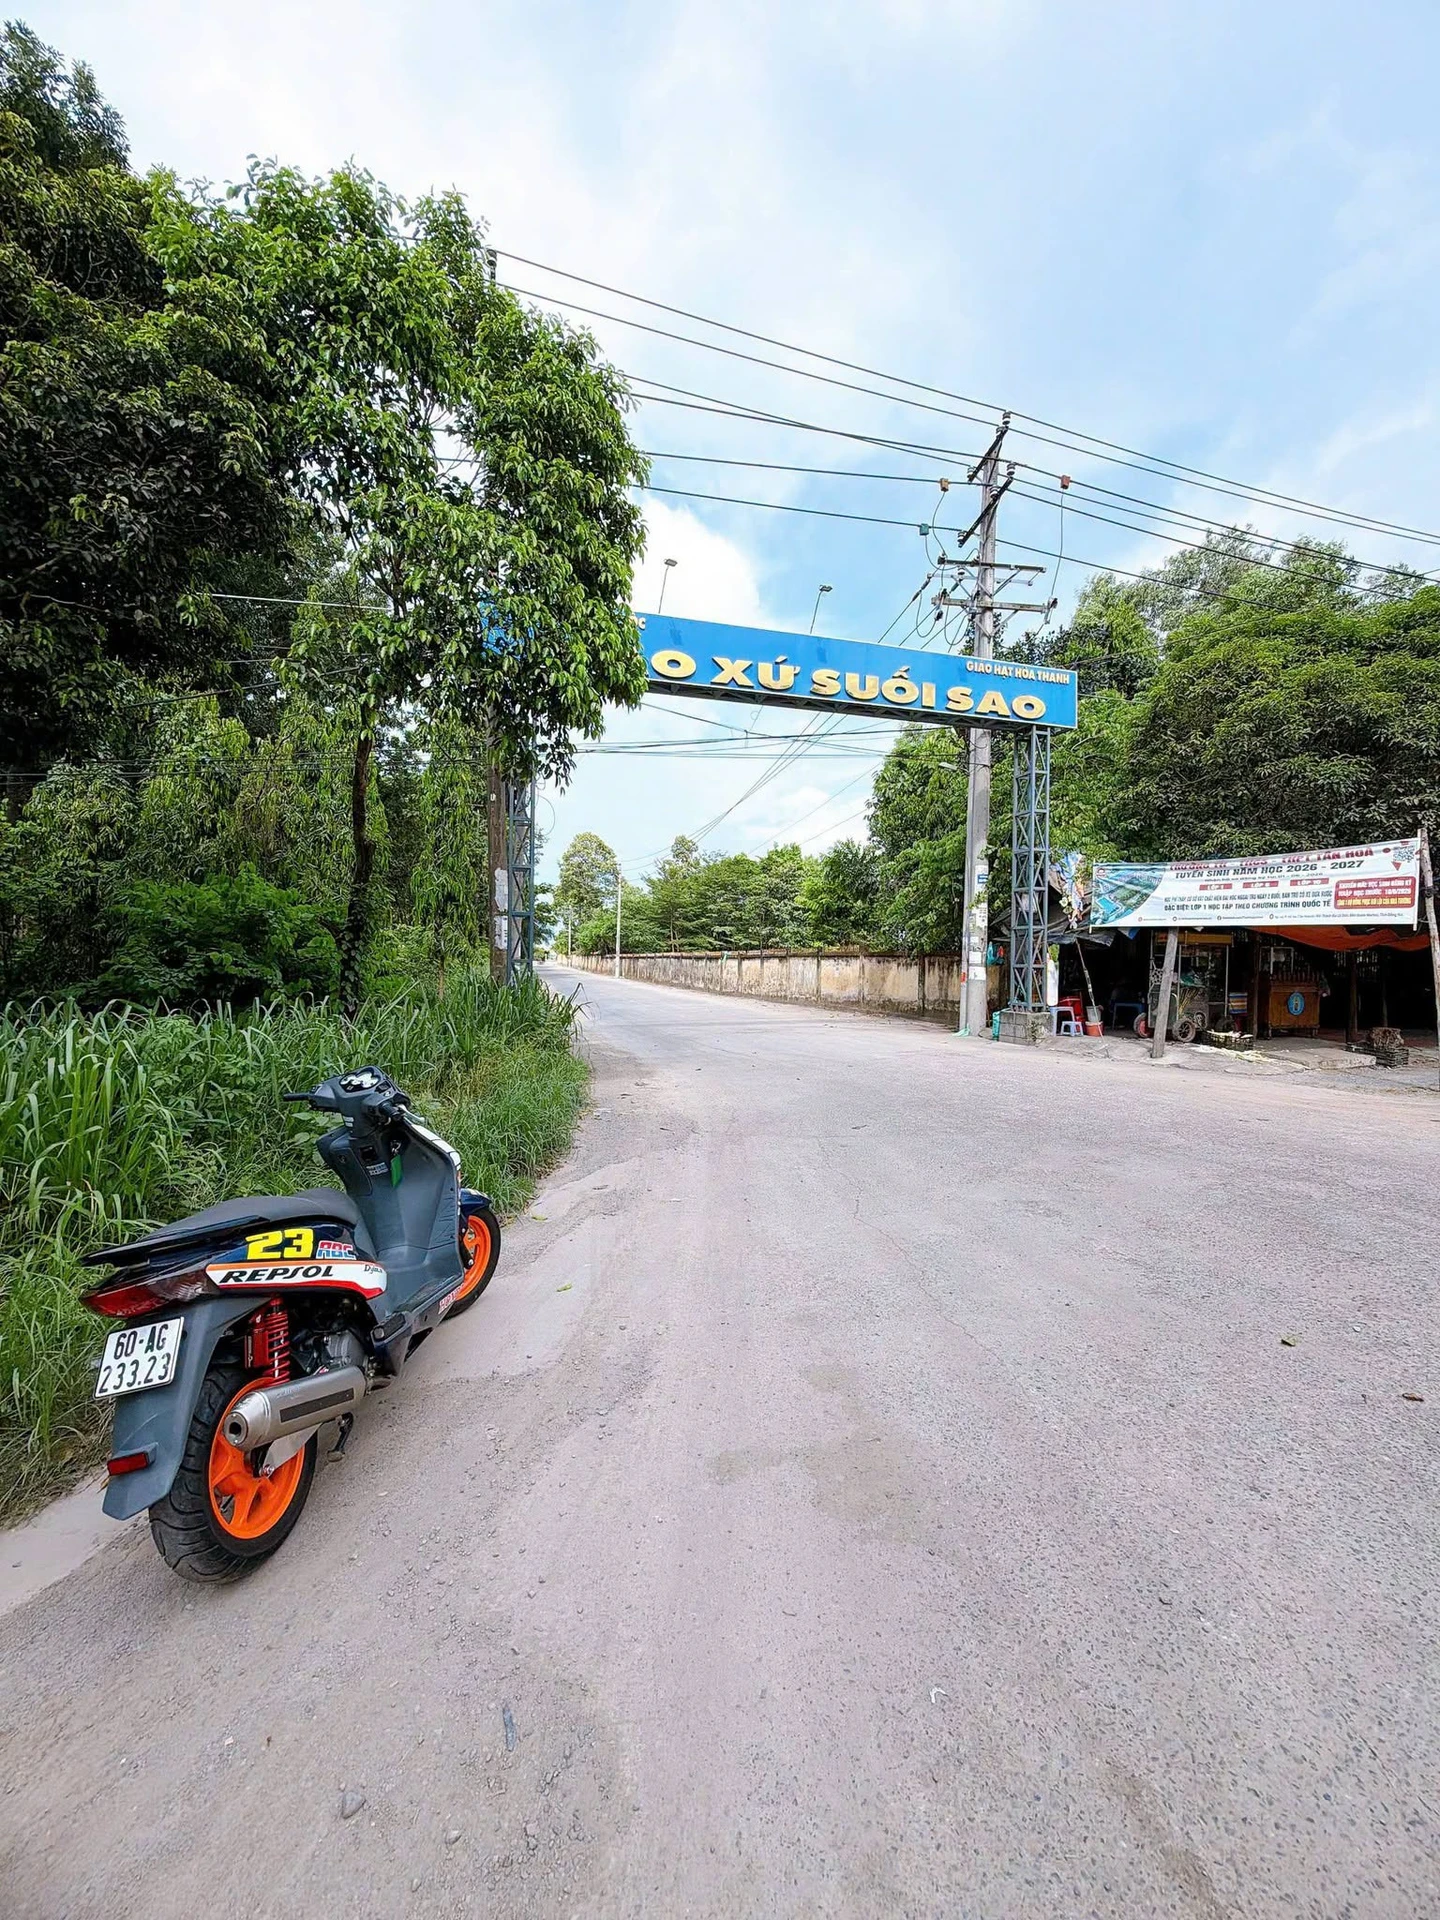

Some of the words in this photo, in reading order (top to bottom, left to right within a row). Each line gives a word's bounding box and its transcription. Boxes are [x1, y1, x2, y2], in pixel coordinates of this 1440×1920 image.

[711, 655, 800, 690] XỨ
[810, 665, 936, 708] SUỐI
[946, 686, 1047, 719] SAO
[994, 665, 1013, 678] HẠT
[1037, 670, 1070, 684] THANH
[1206, 869, 1230, 878] SINH
[1232, 866, 1258, 876] NĂM
[1260, 866, 1283, 875] HỌC
[1286, 863, 1318, 873] 2026
[1330, 859, 1365, 870] 2027
[1280, 900, 1300, 908] TRÌNH
[1301, 899, 1321, 908] QUỐC
[1322, 899, 1331, 907] TẾ
[245, 1228, 314, 1260] 23
[219, 1265, 334, 1284] REPSOL
[113, 1323, 169, 1360] 60-AG
[98, 1352, 171, 1394] 233.23
